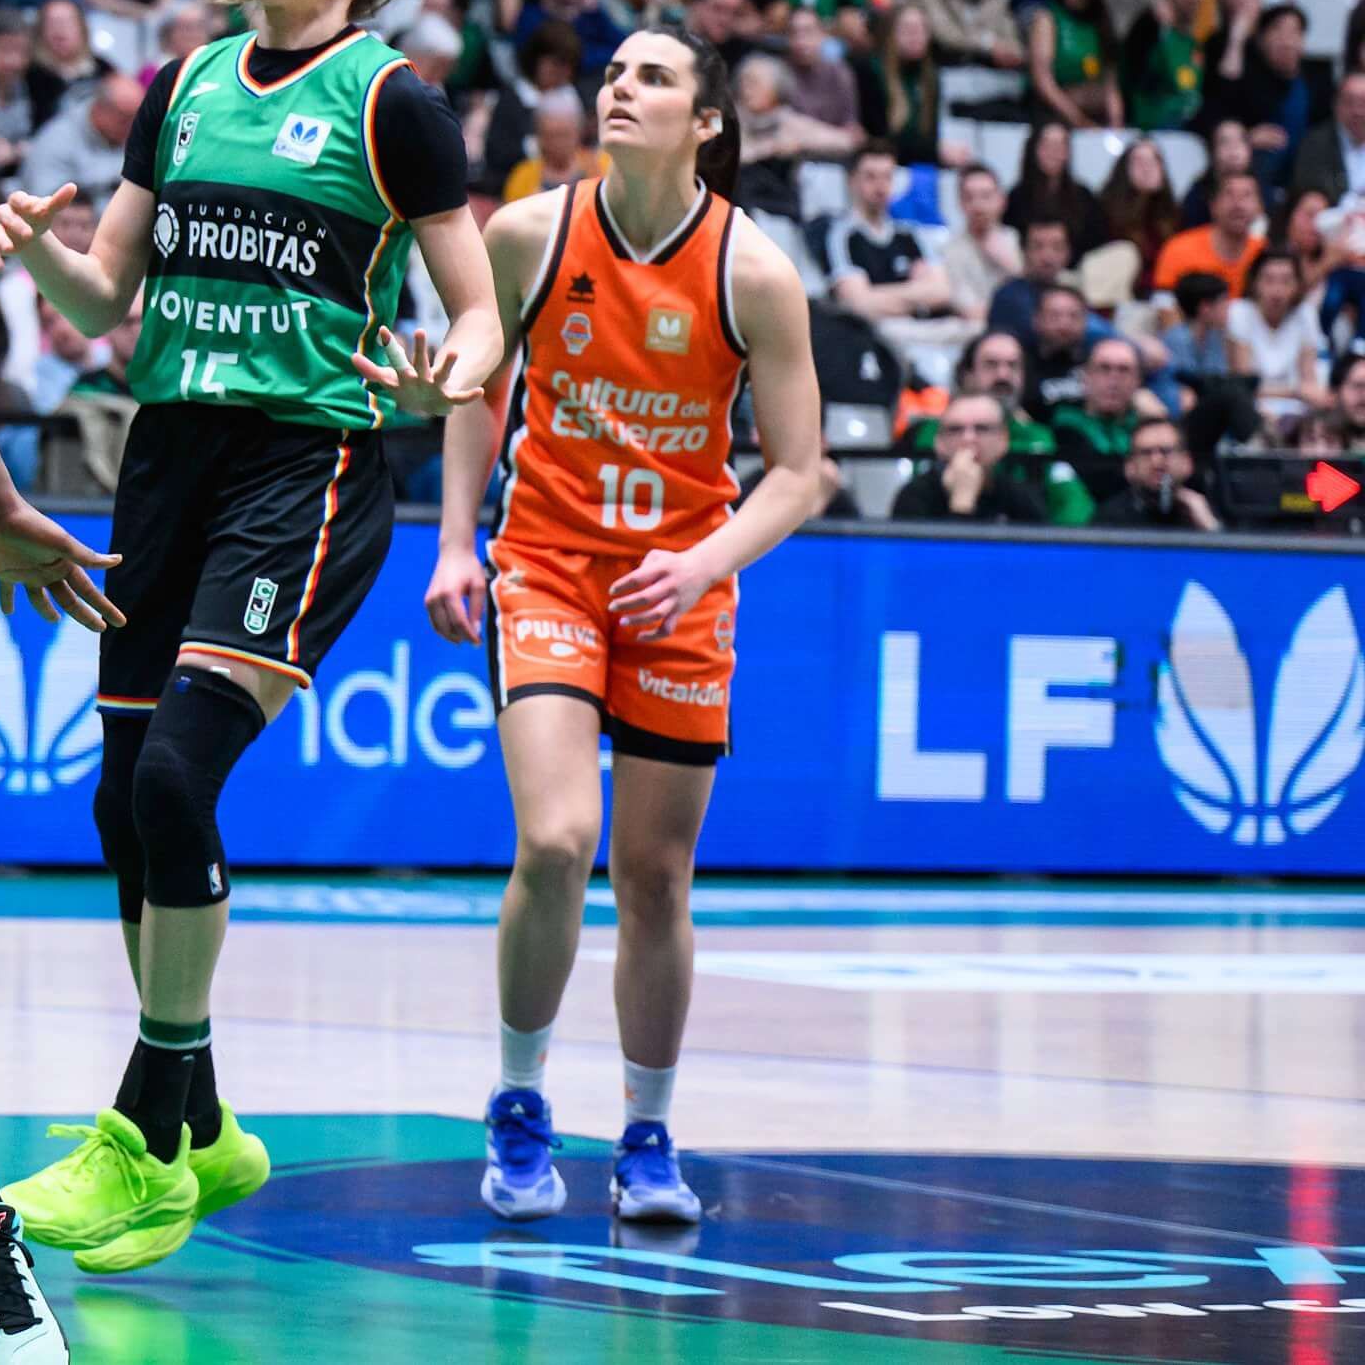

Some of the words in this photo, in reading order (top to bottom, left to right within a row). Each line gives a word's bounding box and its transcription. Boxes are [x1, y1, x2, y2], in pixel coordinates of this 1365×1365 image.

[188, 203, 327, 239] FUNDACIÓN
[188, 220, 321, 276] PROBITAS
[551, 370, 679, 419] Cultura
[680, 400, 710, 418] del
[550, 401, 709, 454] Esfuerzo
[597, 463, 665, 532] 10
[876, 630, 1117, 803] LF
